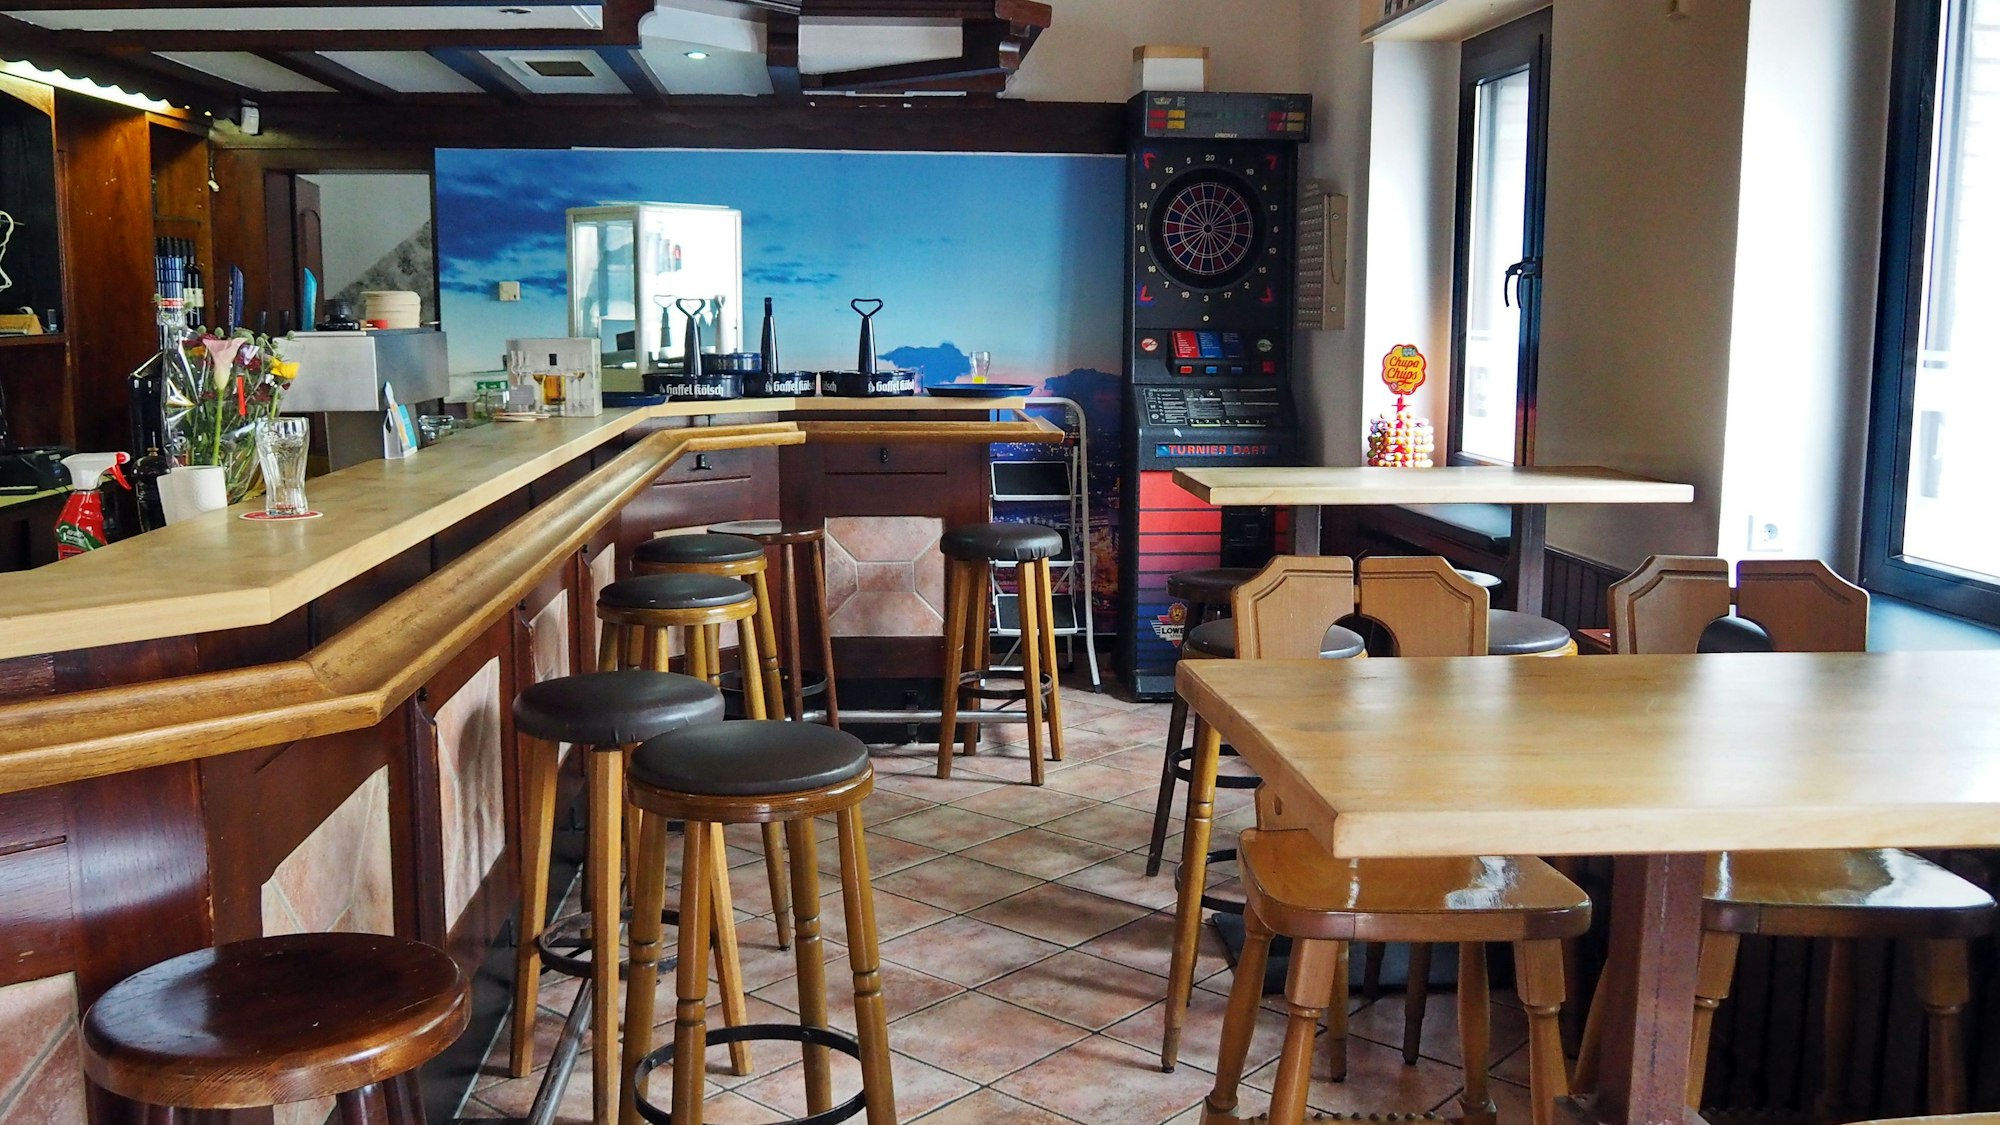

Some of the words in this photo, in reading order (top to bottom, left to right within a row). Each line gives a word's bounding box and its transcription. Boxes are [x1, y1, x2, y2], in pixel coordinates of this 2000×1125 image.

[1205, 154, 1215, 162] 20
[1165, 166, 1174, 174] 12
[1151, 182, 1157, 190] 9
[1389, 356, 1420, 370] Chupa
[1387, 367, 1418, 382] Chups
[666, 383, 693, 396] Gaffel
[694, 384, 724, 397] Kölsch
[774, 380, 798, 392] Gaffel
[876, 380, 899, 392] Gaffel
[1168, 445, 1227, 455] TURNIER
[1232, 445, 1268, 455] DART
